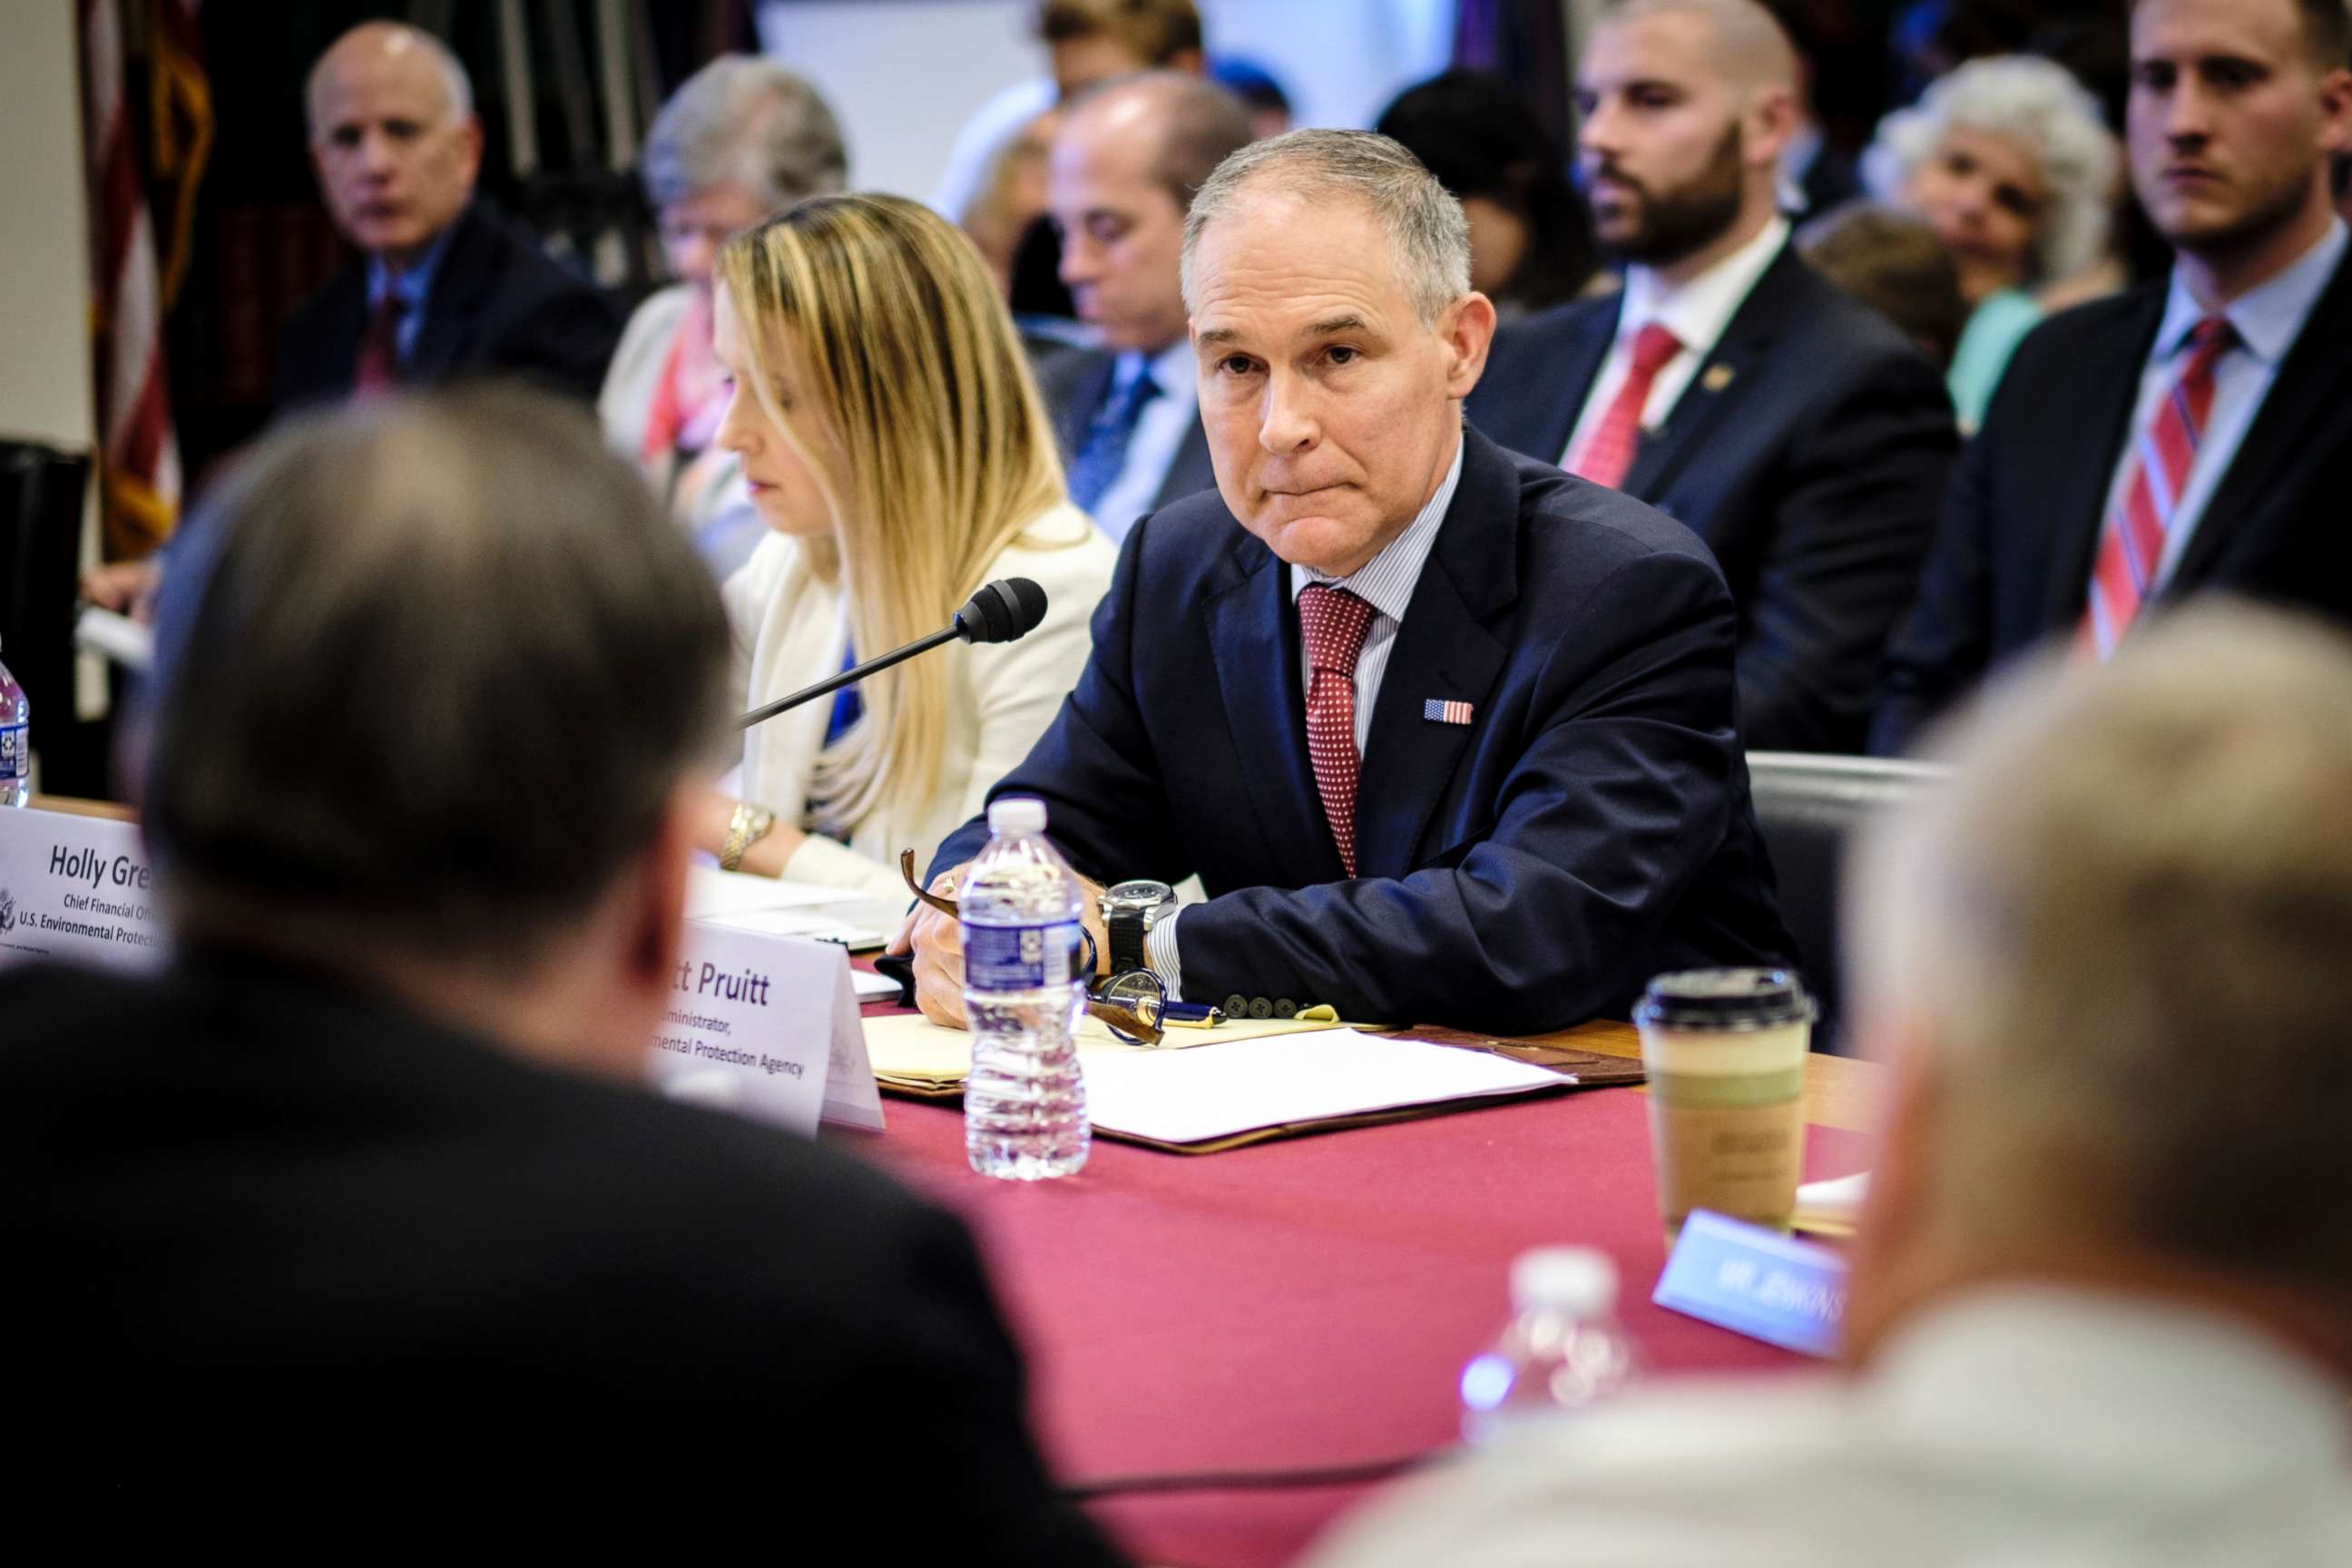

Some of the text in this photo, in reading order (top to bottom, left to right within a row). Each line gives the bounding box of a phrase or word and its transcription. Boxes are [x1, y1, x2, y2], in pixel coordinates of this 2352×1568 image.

[49, 845, 152, 890] Holly Gre
[64, 894, 90, 910] Chief
[91, 898, 134, 918] Financial
[19, 910, 156, 947] U.S. Environmental Protect
[698, 963, 770, 1006] Pruitt
[662, 1009, 731, 1037] ministrator,
[695, 1040, 757, 1068] Protection
[759, 1054, 805, 1079] Agency
